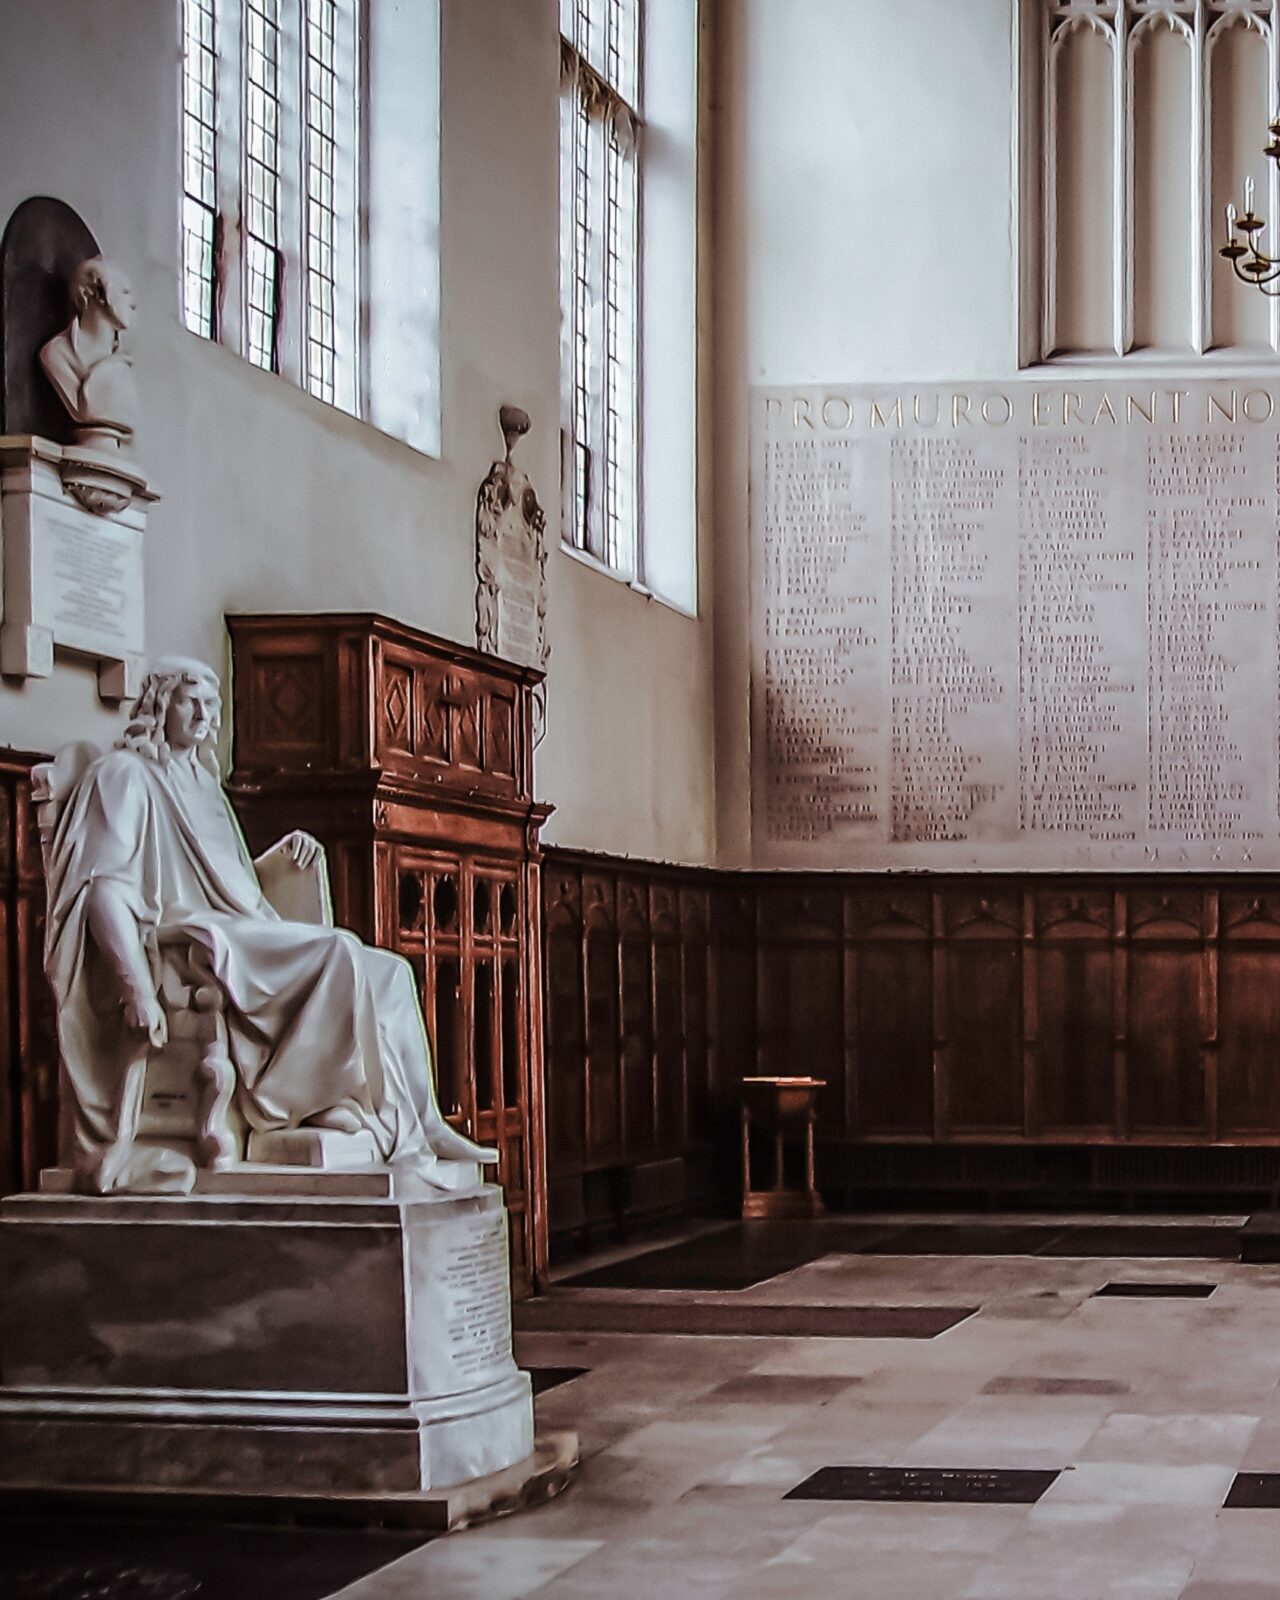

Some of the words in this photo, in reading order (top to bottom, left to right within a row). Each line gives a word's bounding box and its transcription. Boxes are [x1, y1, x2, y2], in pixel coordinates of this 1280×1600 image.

[766, 396, 854, 430] PRO
[869, 393, 1014, 430] MURO
[1031, 390, 1190, 427] ERANT
